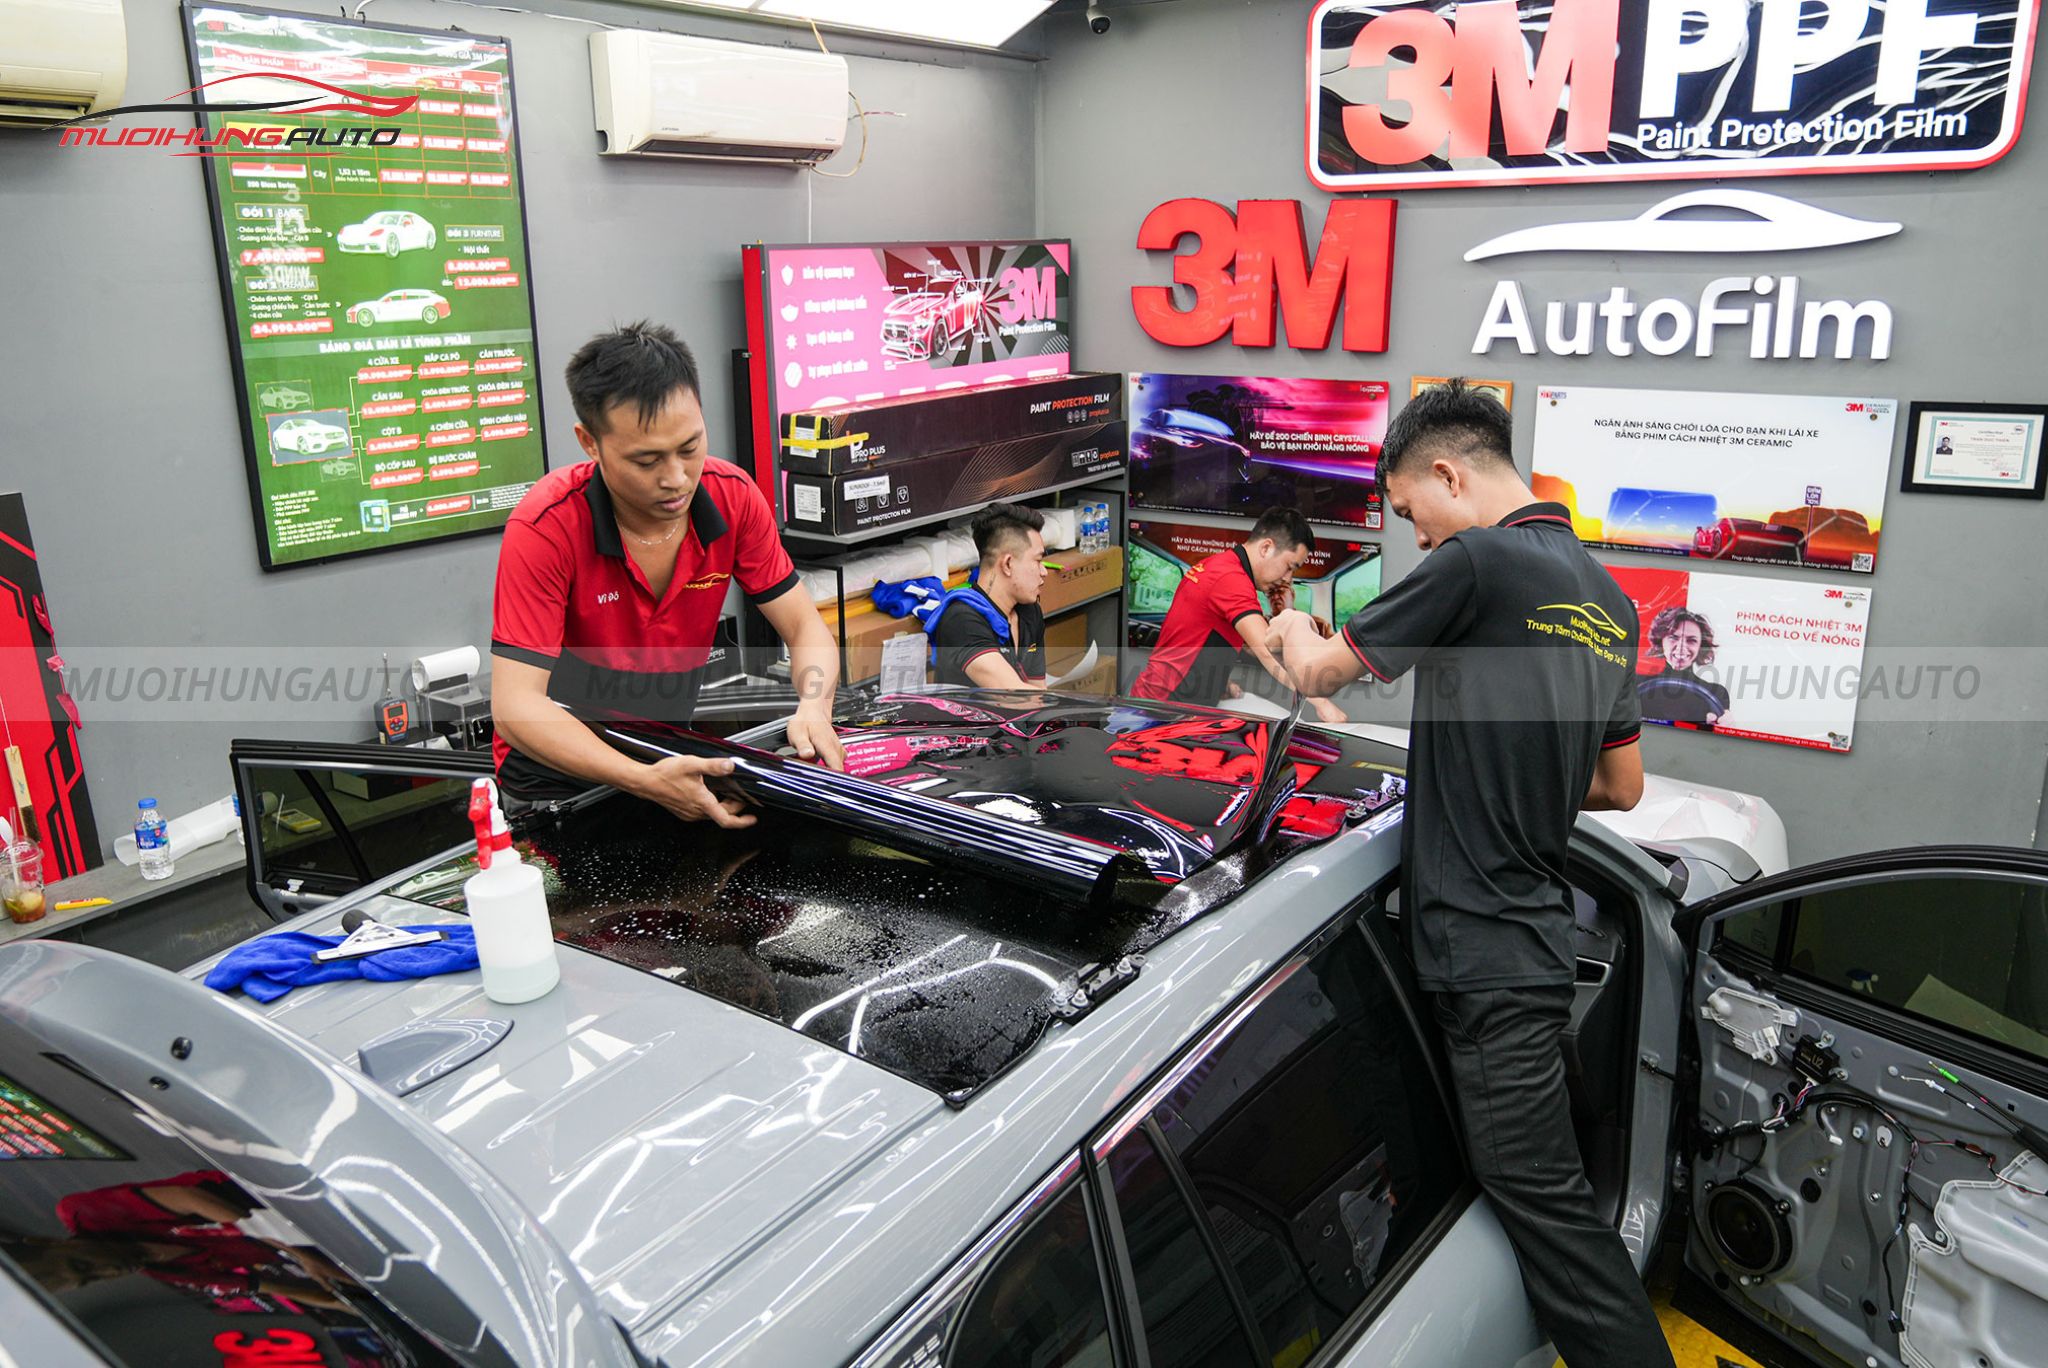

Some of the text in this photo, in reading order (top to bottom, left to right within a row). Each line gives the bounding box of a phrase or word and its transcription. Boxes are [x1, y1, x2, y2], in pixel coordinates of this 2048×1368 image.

[1342, 0, 1620, 165] 3M
[1637, 107, 1968, 149] Paint Protection Film
[1131, 197, 1398, 352] 3M
[999, 266, 1057, 324] 3M
[1471, 275, 1894, 360] AutoFilm
[999, 321, 1057, 336] Paint Protection Film
[1030, 393, 1110, 414] PAINT PROTECTION FILM
[1845, 403, 1864, 412] 3M
[1250, 430, 1264, 440] HÃY
[1276, 432, 1289, 441] 200
[1291, 431, 1313, 441] CHIẾN
[1314, 433, 1332, 441] BINH
[1623, 419, 1643, 429] ÁNH
[1646, 420, 1671, 431] SÁNG
[1674, 422, 1698, 432] CHÓI
[1700, 423, 1719, 433] LÓA
[1722, 425, 1744, 434] CHO
[1746, 426, 1767, 437] BẠN
[1769, 428, 1786, 436] KHI
[1788, 428, 1804, 437] LÁI
[1806, 430, 1819, 438] XE
[1261, 440, 1369, 452] BẢO VỆ BẠN KHỎI NẮNG NÓNG
[1615, 429, 1793, 448] BẰNG PHIM CÁCH NHIỆT 3M CERAMIC
[869, 445, 886, 455] PLUS
[857, 508, 911, 525] PAINT PROTECTION FILM
[1172, 536, 1183, 545] HÃY
[1184, 536, 1201, 546] DÀNH
[1177, 544, 1190, 552] NHƯ
[1192, 544, 1209, 553] CÁCH
[1311, 558, 1324, 566] BẠN
[1824, 589, 1842, 599] 3M
[1526, 619, 1553, 634] Trung
[1554, 624, 1570, 637] Tâm
[1736, 611, 1862, 633] PHIM CÁCH NHIỆT 3M
[1735, 624, 1780, 638] KHÔNG
[1784, 630, 1800, 640] LO
[1821, 633, 1860, 647] NÓNG
